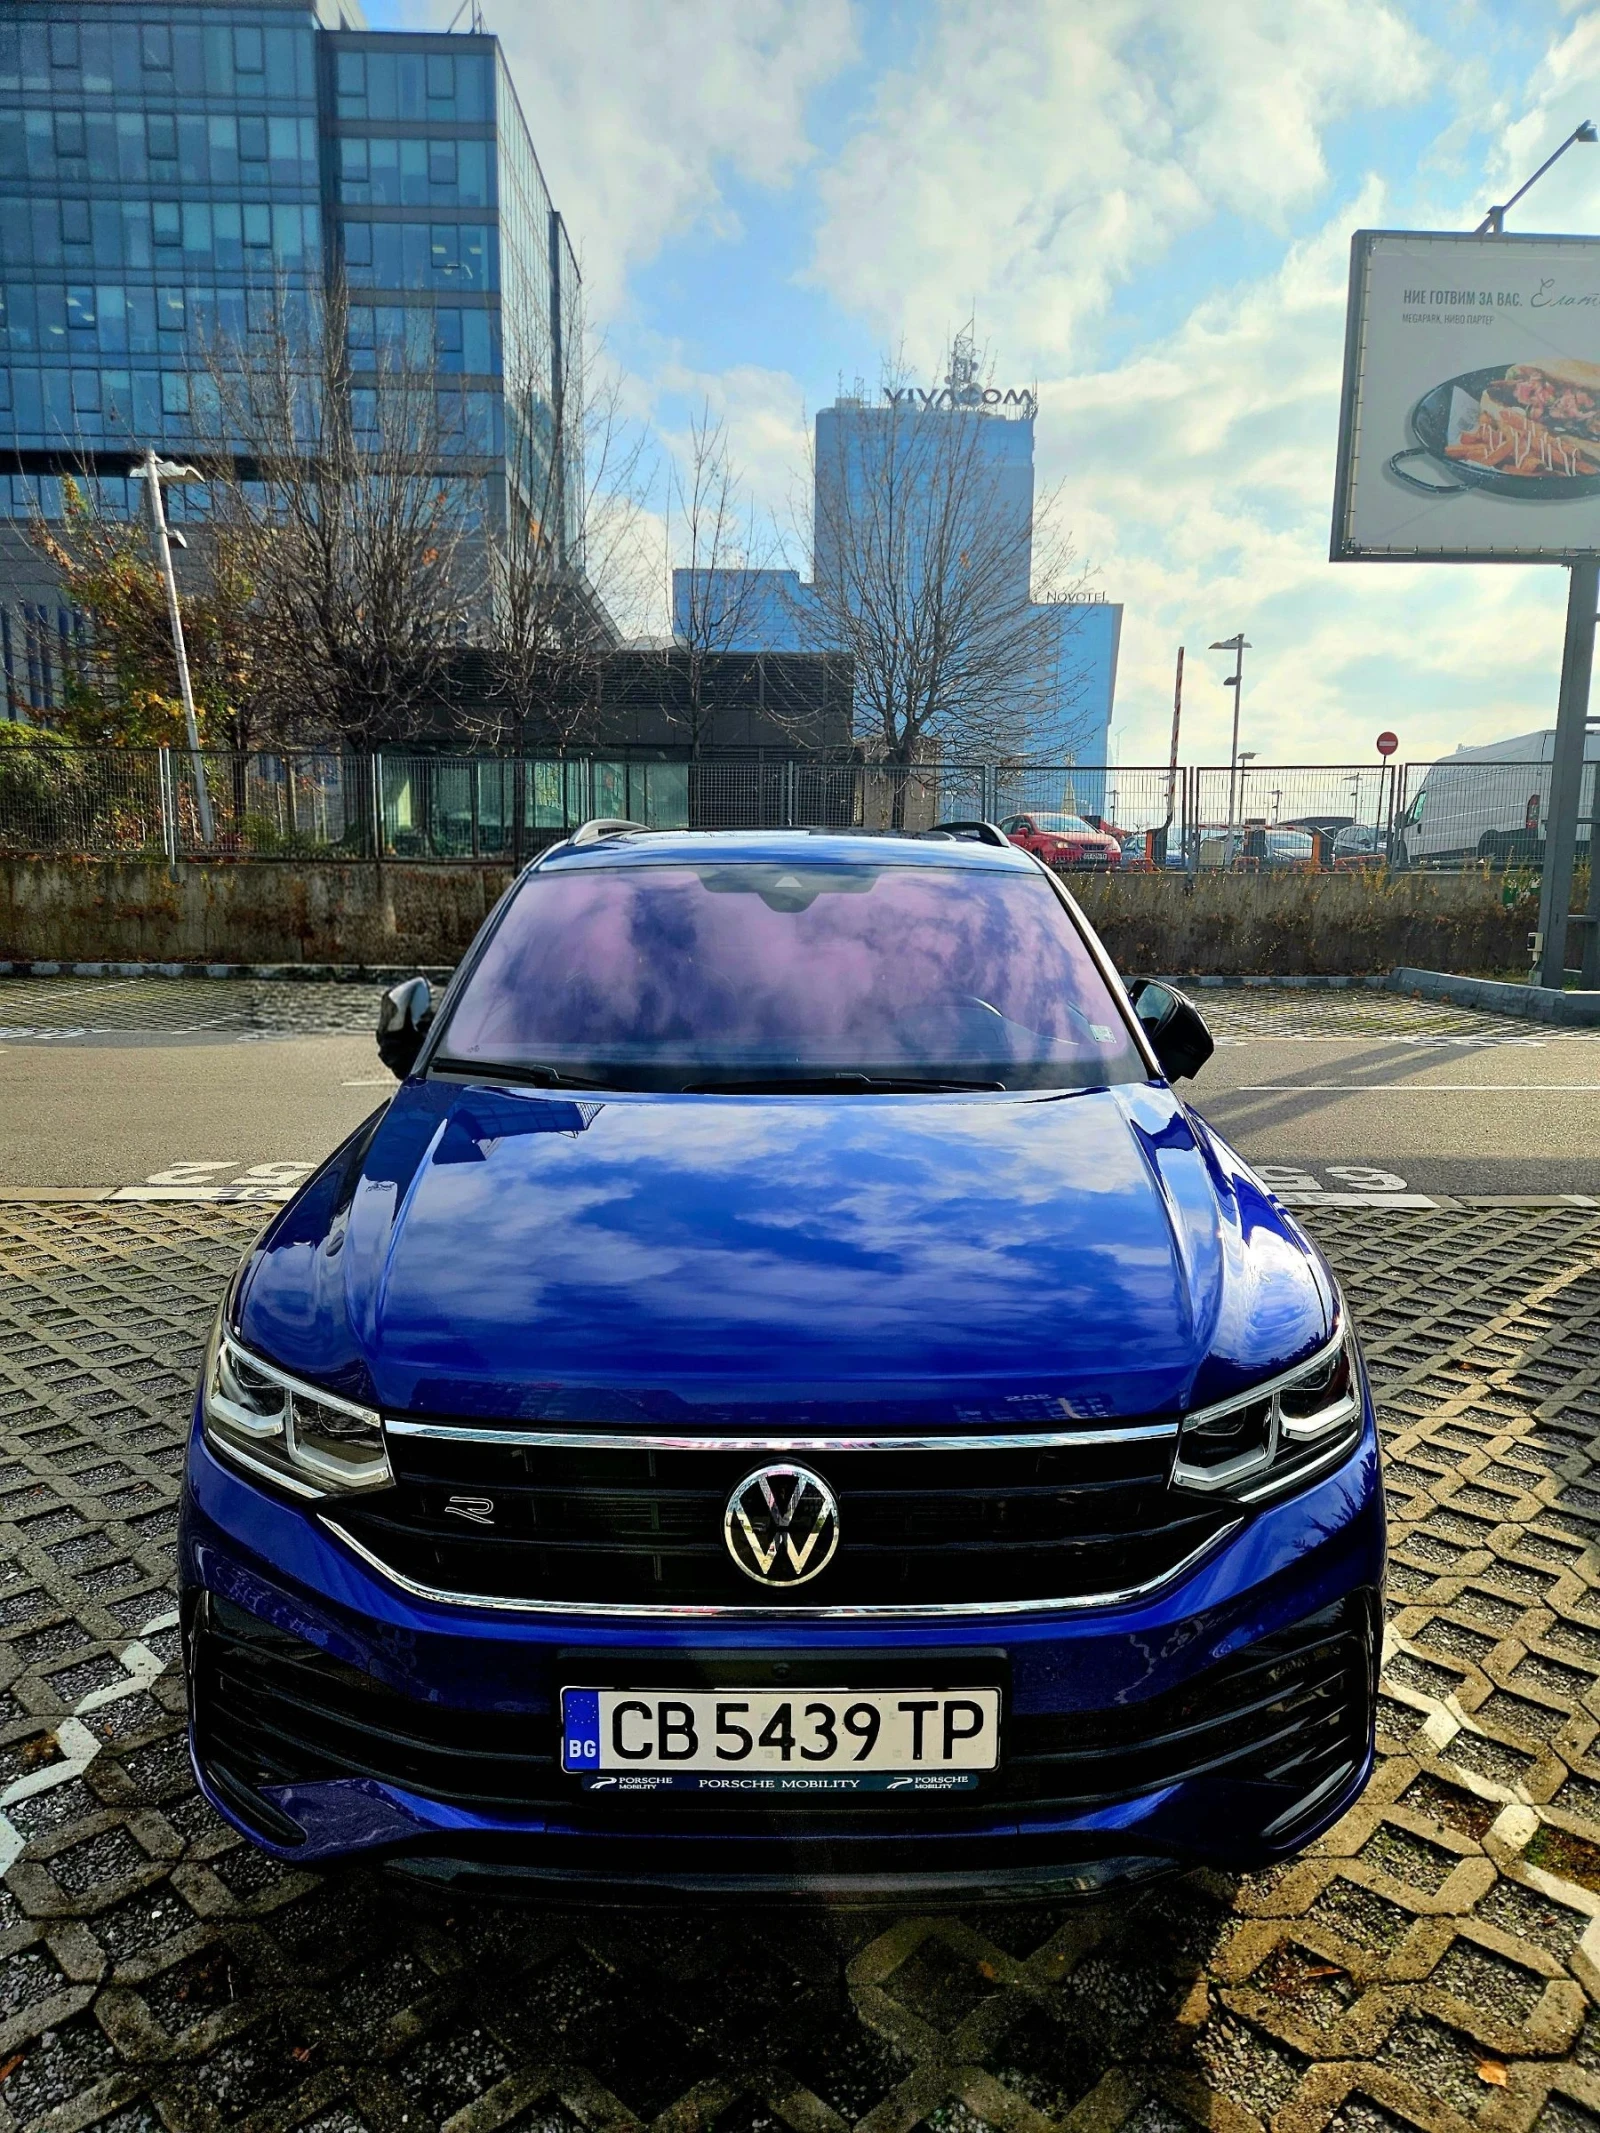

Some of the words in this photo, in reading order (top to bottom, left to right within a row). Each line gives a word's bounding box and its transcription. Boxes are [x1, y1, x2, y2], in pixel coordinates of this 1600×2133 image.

[1403, 289, 1426, 305] НИЕ
[1429, 290, 1476, 306] ГОТВИМ
[1479, 291, 1494, 306] ЗА
[1497, 292, 1523, 307] ВАС.
[1530, 277, 1600, 308] Елат
[1444, 314, 1466, 325] НИВО
[1466, 314, 1495, 325] ПАРТЕР
[882, 387, 1034, 406] VIVAOM
[611, 1700, 699, 1762] CB
[715, 1702, 882, 1762] 5439
[898, 1700, 985, 1761] TP
[568, 1739, 597, 1759] BG
[618, 1776, 673, 1784] PORSCHE
[698, 1779, 775, 1789] PORSCHE
[781, 1779, 861, 1789] MOBILITY
[914, 1776, 969, 1784] PORSCHE
